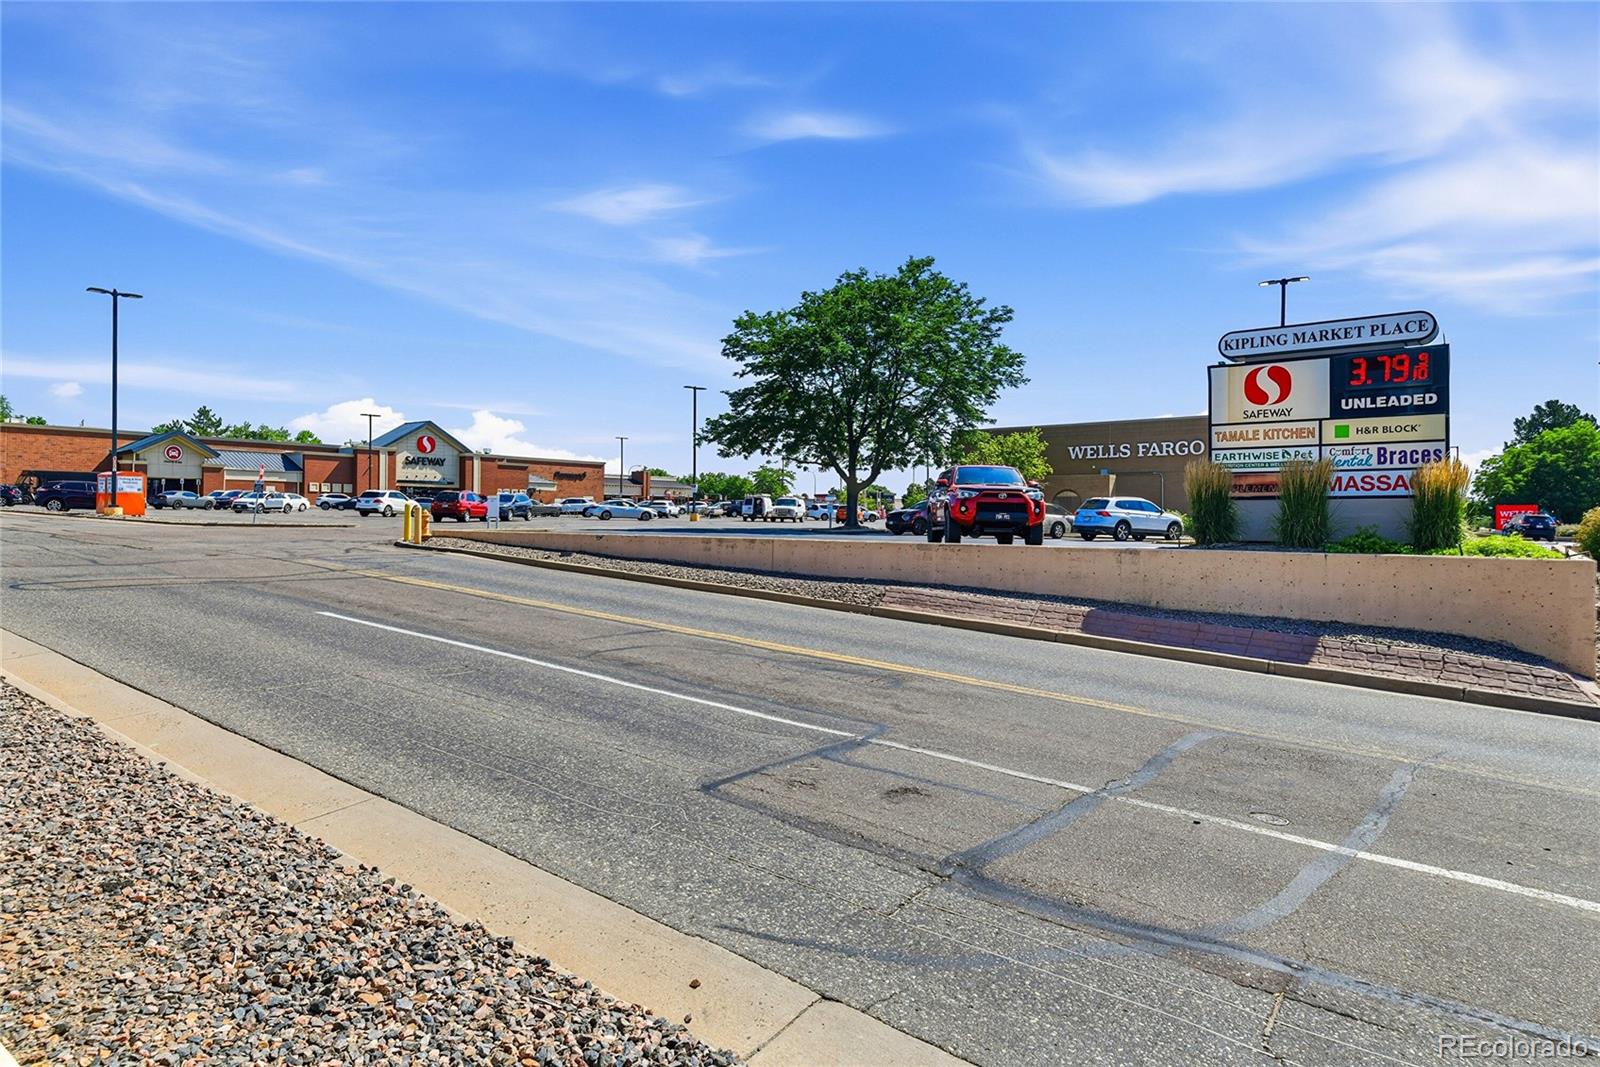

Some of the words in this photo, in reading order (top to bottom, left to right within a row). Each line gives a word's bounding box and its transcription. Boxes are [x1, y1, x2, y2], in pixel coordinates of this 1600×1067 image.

[1223, 333, 1288, 351] KIPLING
[1292, 325, 1366, 344] MARKET
[1369, 318, 1429, 337] PLACE
[1340, 392, 1438, 410] UNLEADED
[1243, 407, 1293, 419] SAFEWAY
[1214, 429, 1260, 443] TAMALE
[1263, 426, 1316, 441] KITCHEN
[1355, 426, 1379, 435] H&R
[1382, 424, 1418, 434] BLOCK
[1067, 443, 1131, 460] WELLS
[1136, 439, 1206, 458] FARGO
[1294, 449, 1313, 460] Pet
[1376, 446, 1443, 466] Braces
[404, 455, 446, 467] SAFEWAY
